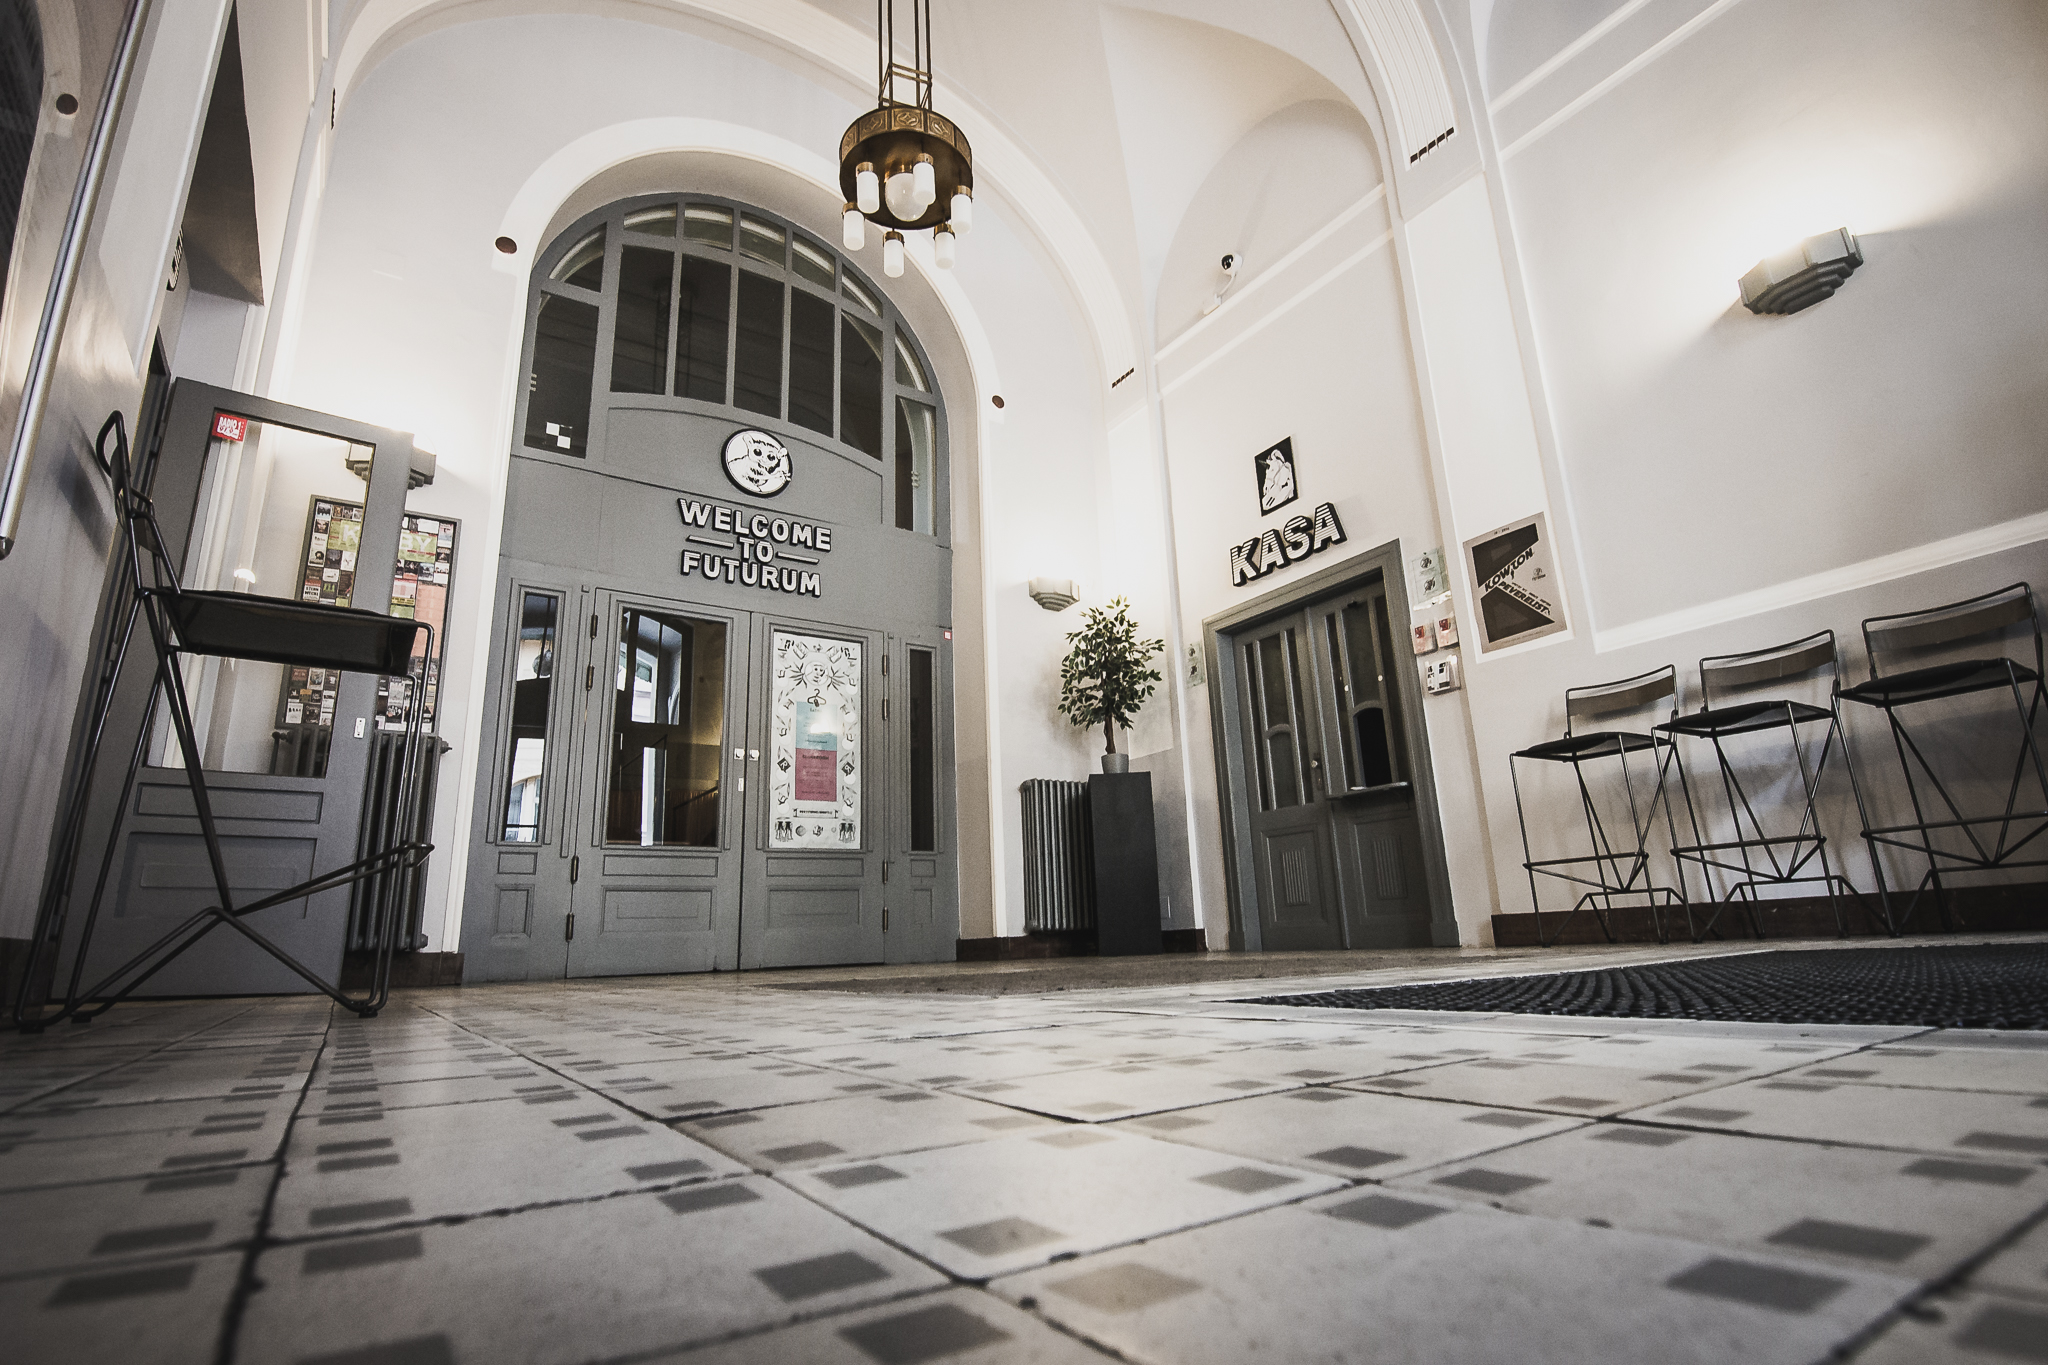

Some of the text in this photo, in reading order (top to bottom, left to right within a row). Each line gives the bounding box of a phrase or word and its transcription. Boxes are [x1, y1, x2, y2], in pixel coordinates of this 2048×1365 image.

[677, 498, 831, 551] WELCOME
[1230, 502, 1347, 587] KASA
[737, 536, 774, 563] TO
[1484, 546, 1535, 592] KOWTON
[681, 550, 821, 597] FUTURUM
[1498, 580, 1550, 615] PEVERELIST
